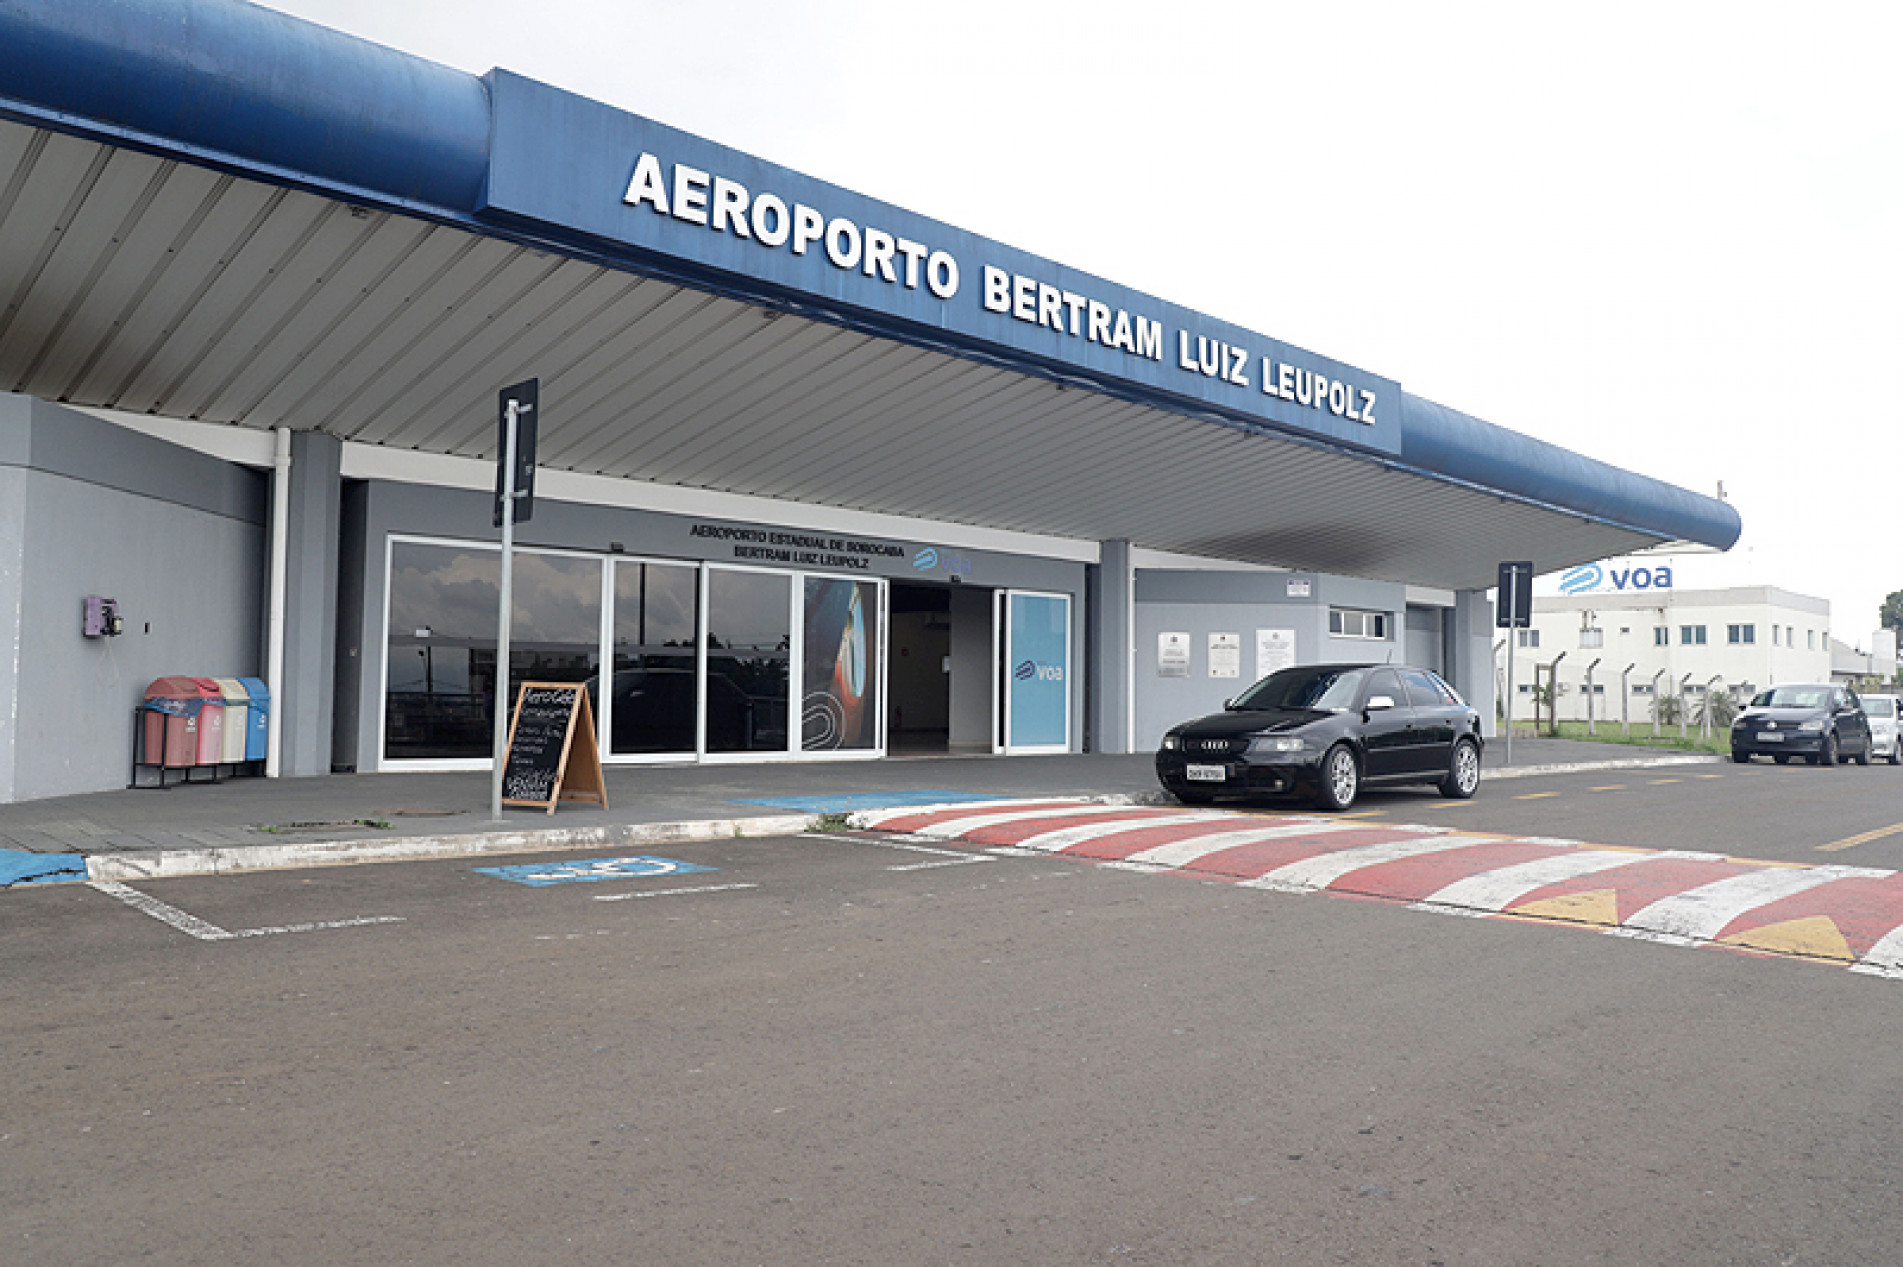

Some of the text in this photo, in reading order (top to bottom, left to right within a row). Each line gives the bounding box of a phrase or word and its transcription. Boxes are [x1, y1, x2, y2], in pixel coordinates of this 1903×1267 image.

[622, 151, 1377, 425] AEROPORTO BERTRAM LUIZ LEUPOLZ
[690, 524, 767, 543] AEROPORTO
[770, 531, 828, 549] ESTADUAL
[829, 539, 845, 552] DE
[734, 545, 869, 569] BERTRAM LUIZ LEUPOLZ
[941, 554, 972, 575] voa
[1610, 567, 1673, 590] voa
[1036, 666, 1064, 681] voa
